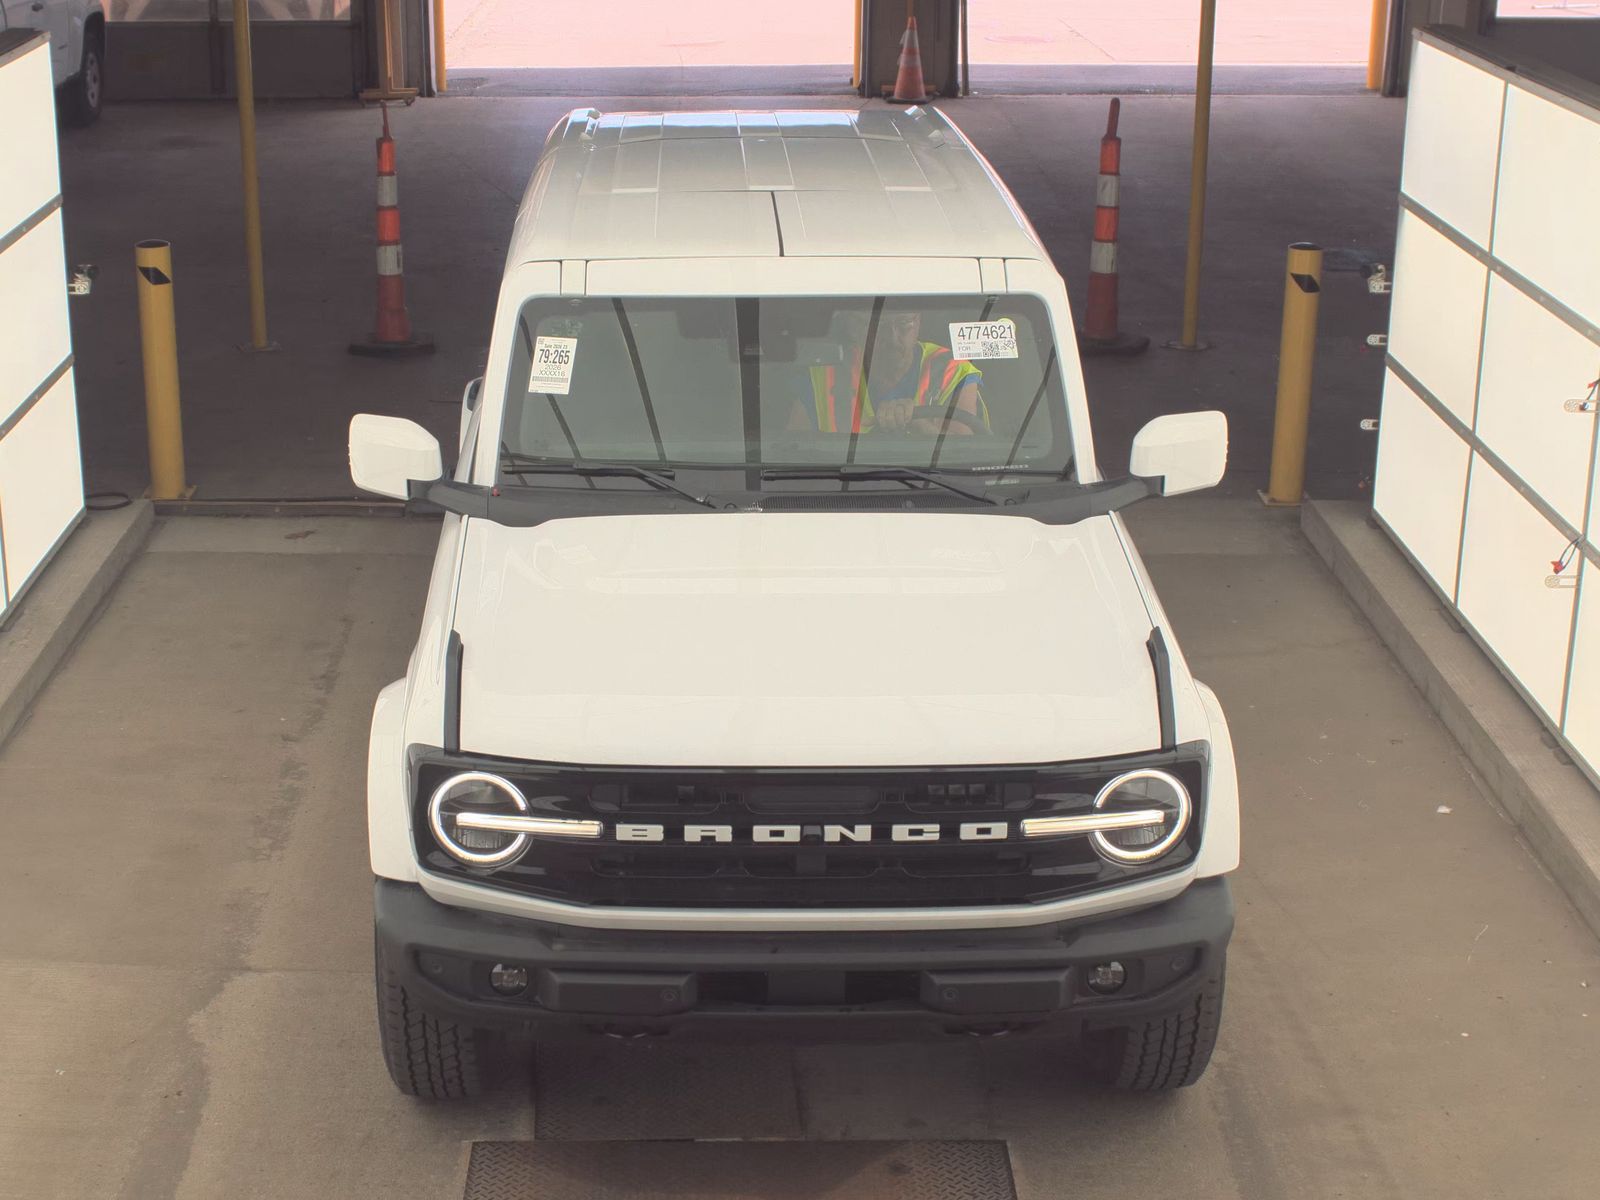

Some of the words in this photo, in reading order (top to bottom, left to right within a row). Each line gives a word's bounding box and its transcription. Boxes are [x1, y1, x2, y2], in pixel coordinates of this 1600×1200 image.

[958, 325, 1012, 340] 4774621
[539, 349, 570, 364] 79:265
[615, 822, 1008, 842] BRONCO
